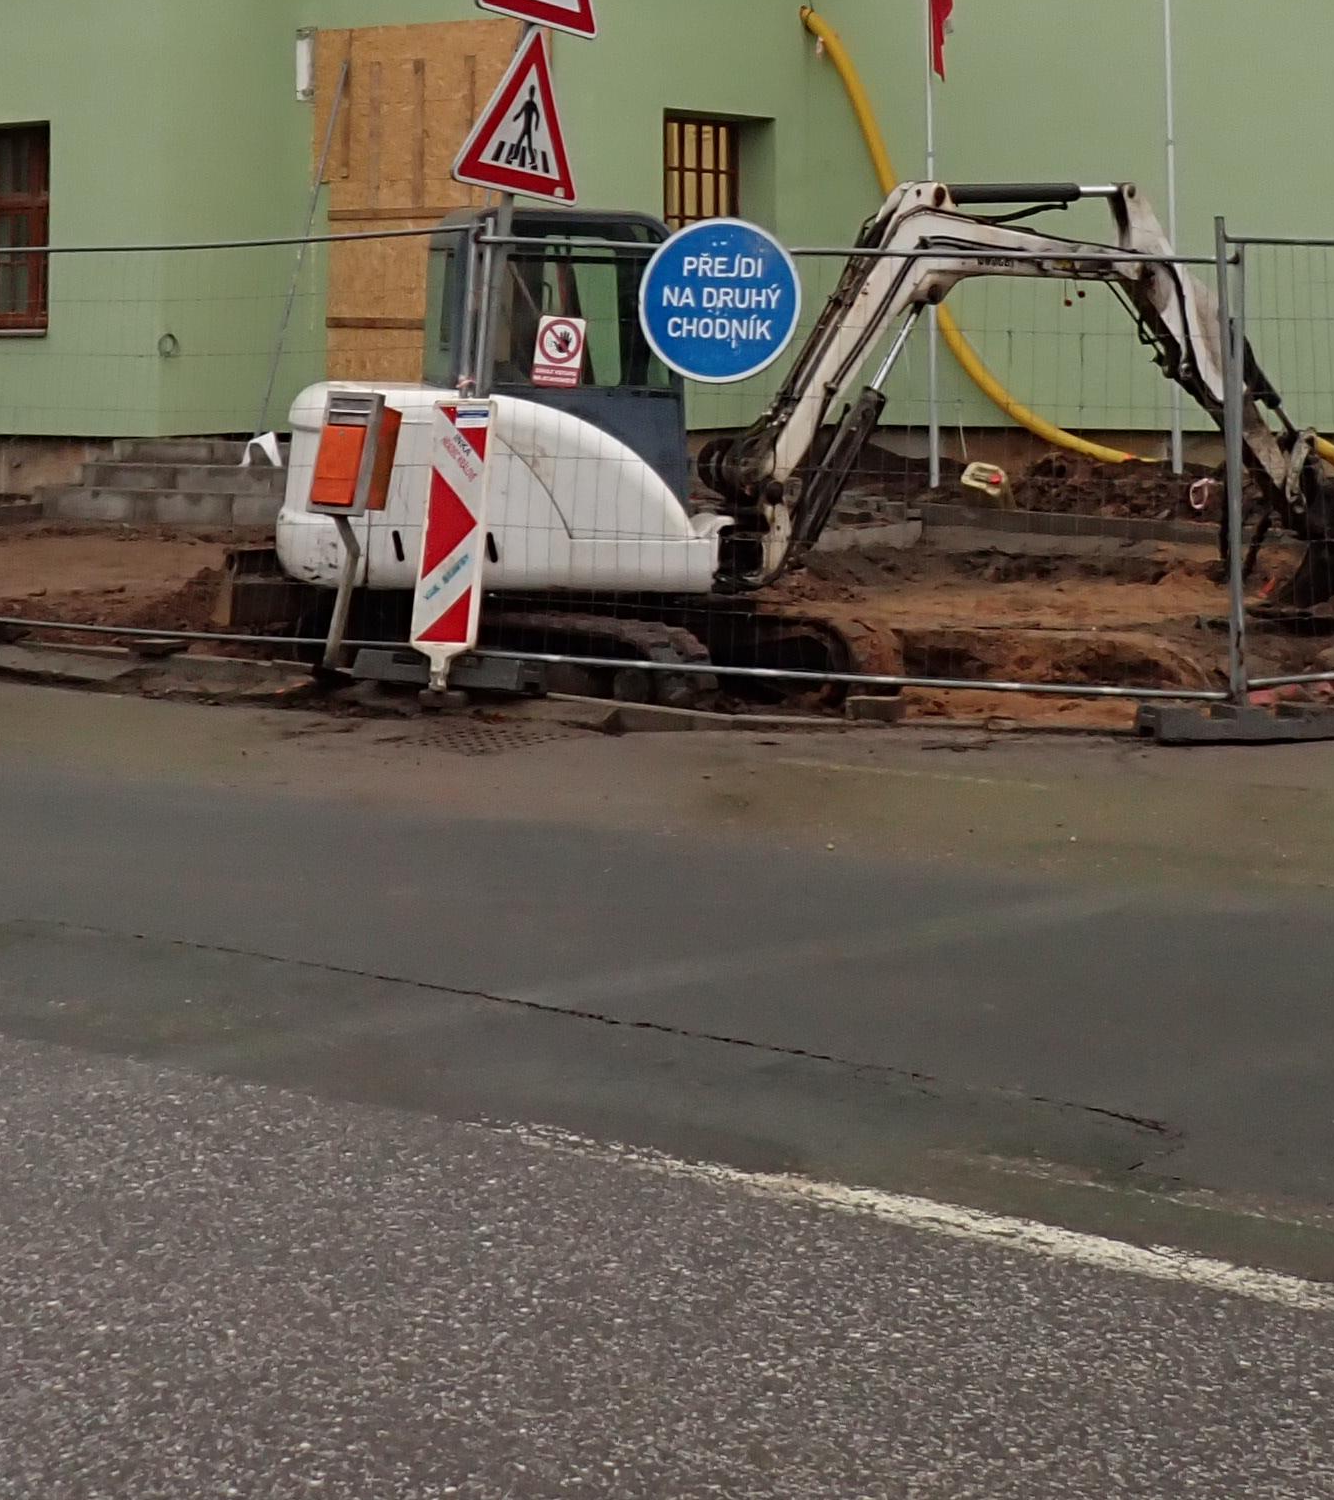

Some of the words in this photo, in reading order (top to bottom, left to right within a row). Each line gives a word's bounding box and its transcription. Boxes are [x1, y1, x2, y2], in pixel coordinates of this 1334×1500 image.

[682, 252, 763, 278] PŘEJDI
[661, 285, 695, 307] NA
[702, 284, 781, 309] DRUHÝ
[667, 314, 772, 340] CHODNÍK
